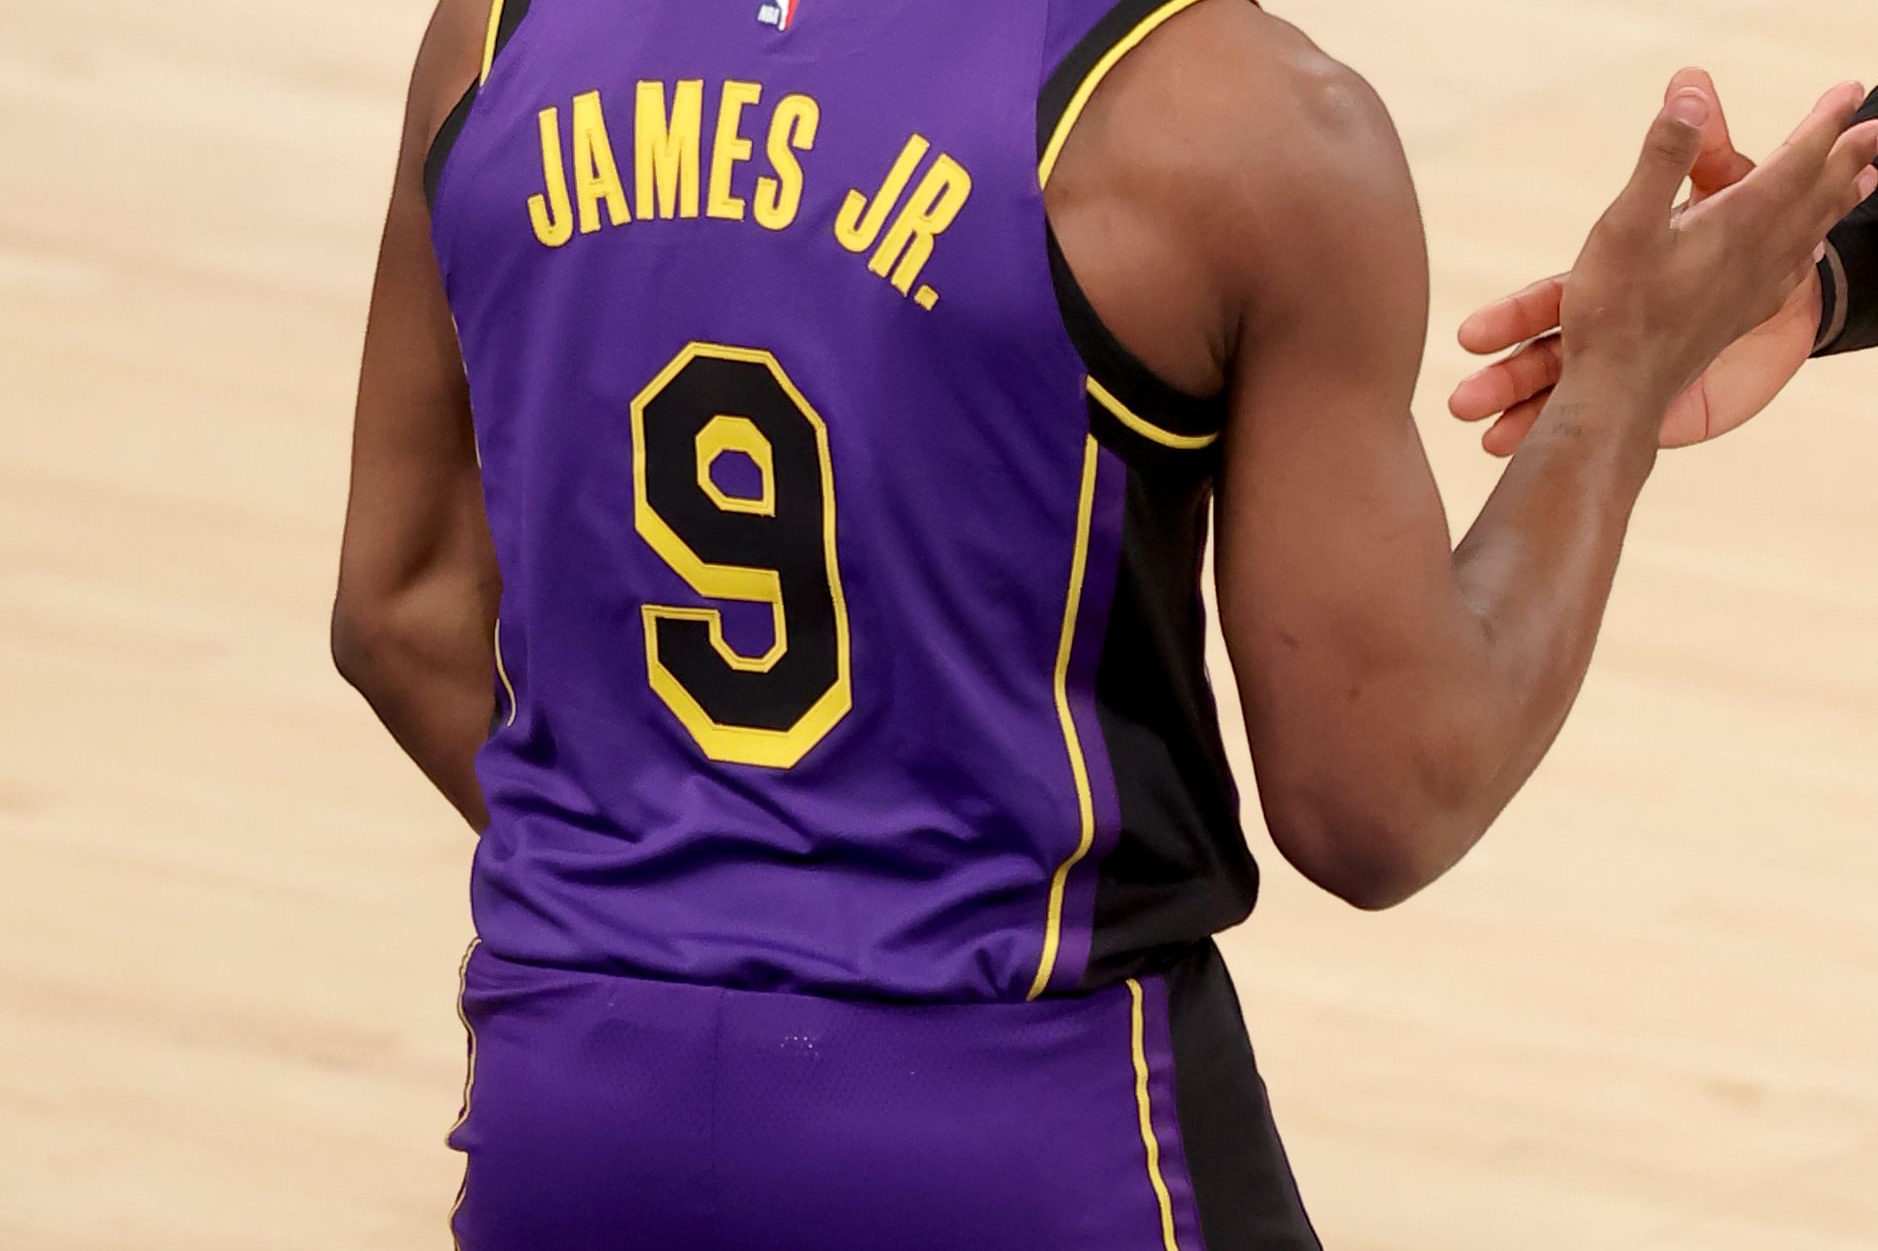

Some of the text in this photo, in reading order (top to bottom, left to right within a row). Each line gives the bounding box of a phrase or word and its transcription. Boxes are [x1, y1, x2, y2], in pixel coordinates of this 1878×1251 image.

[526, 79, 973, 312] JAMES JR.
[629, 341, 852, 770] 9
